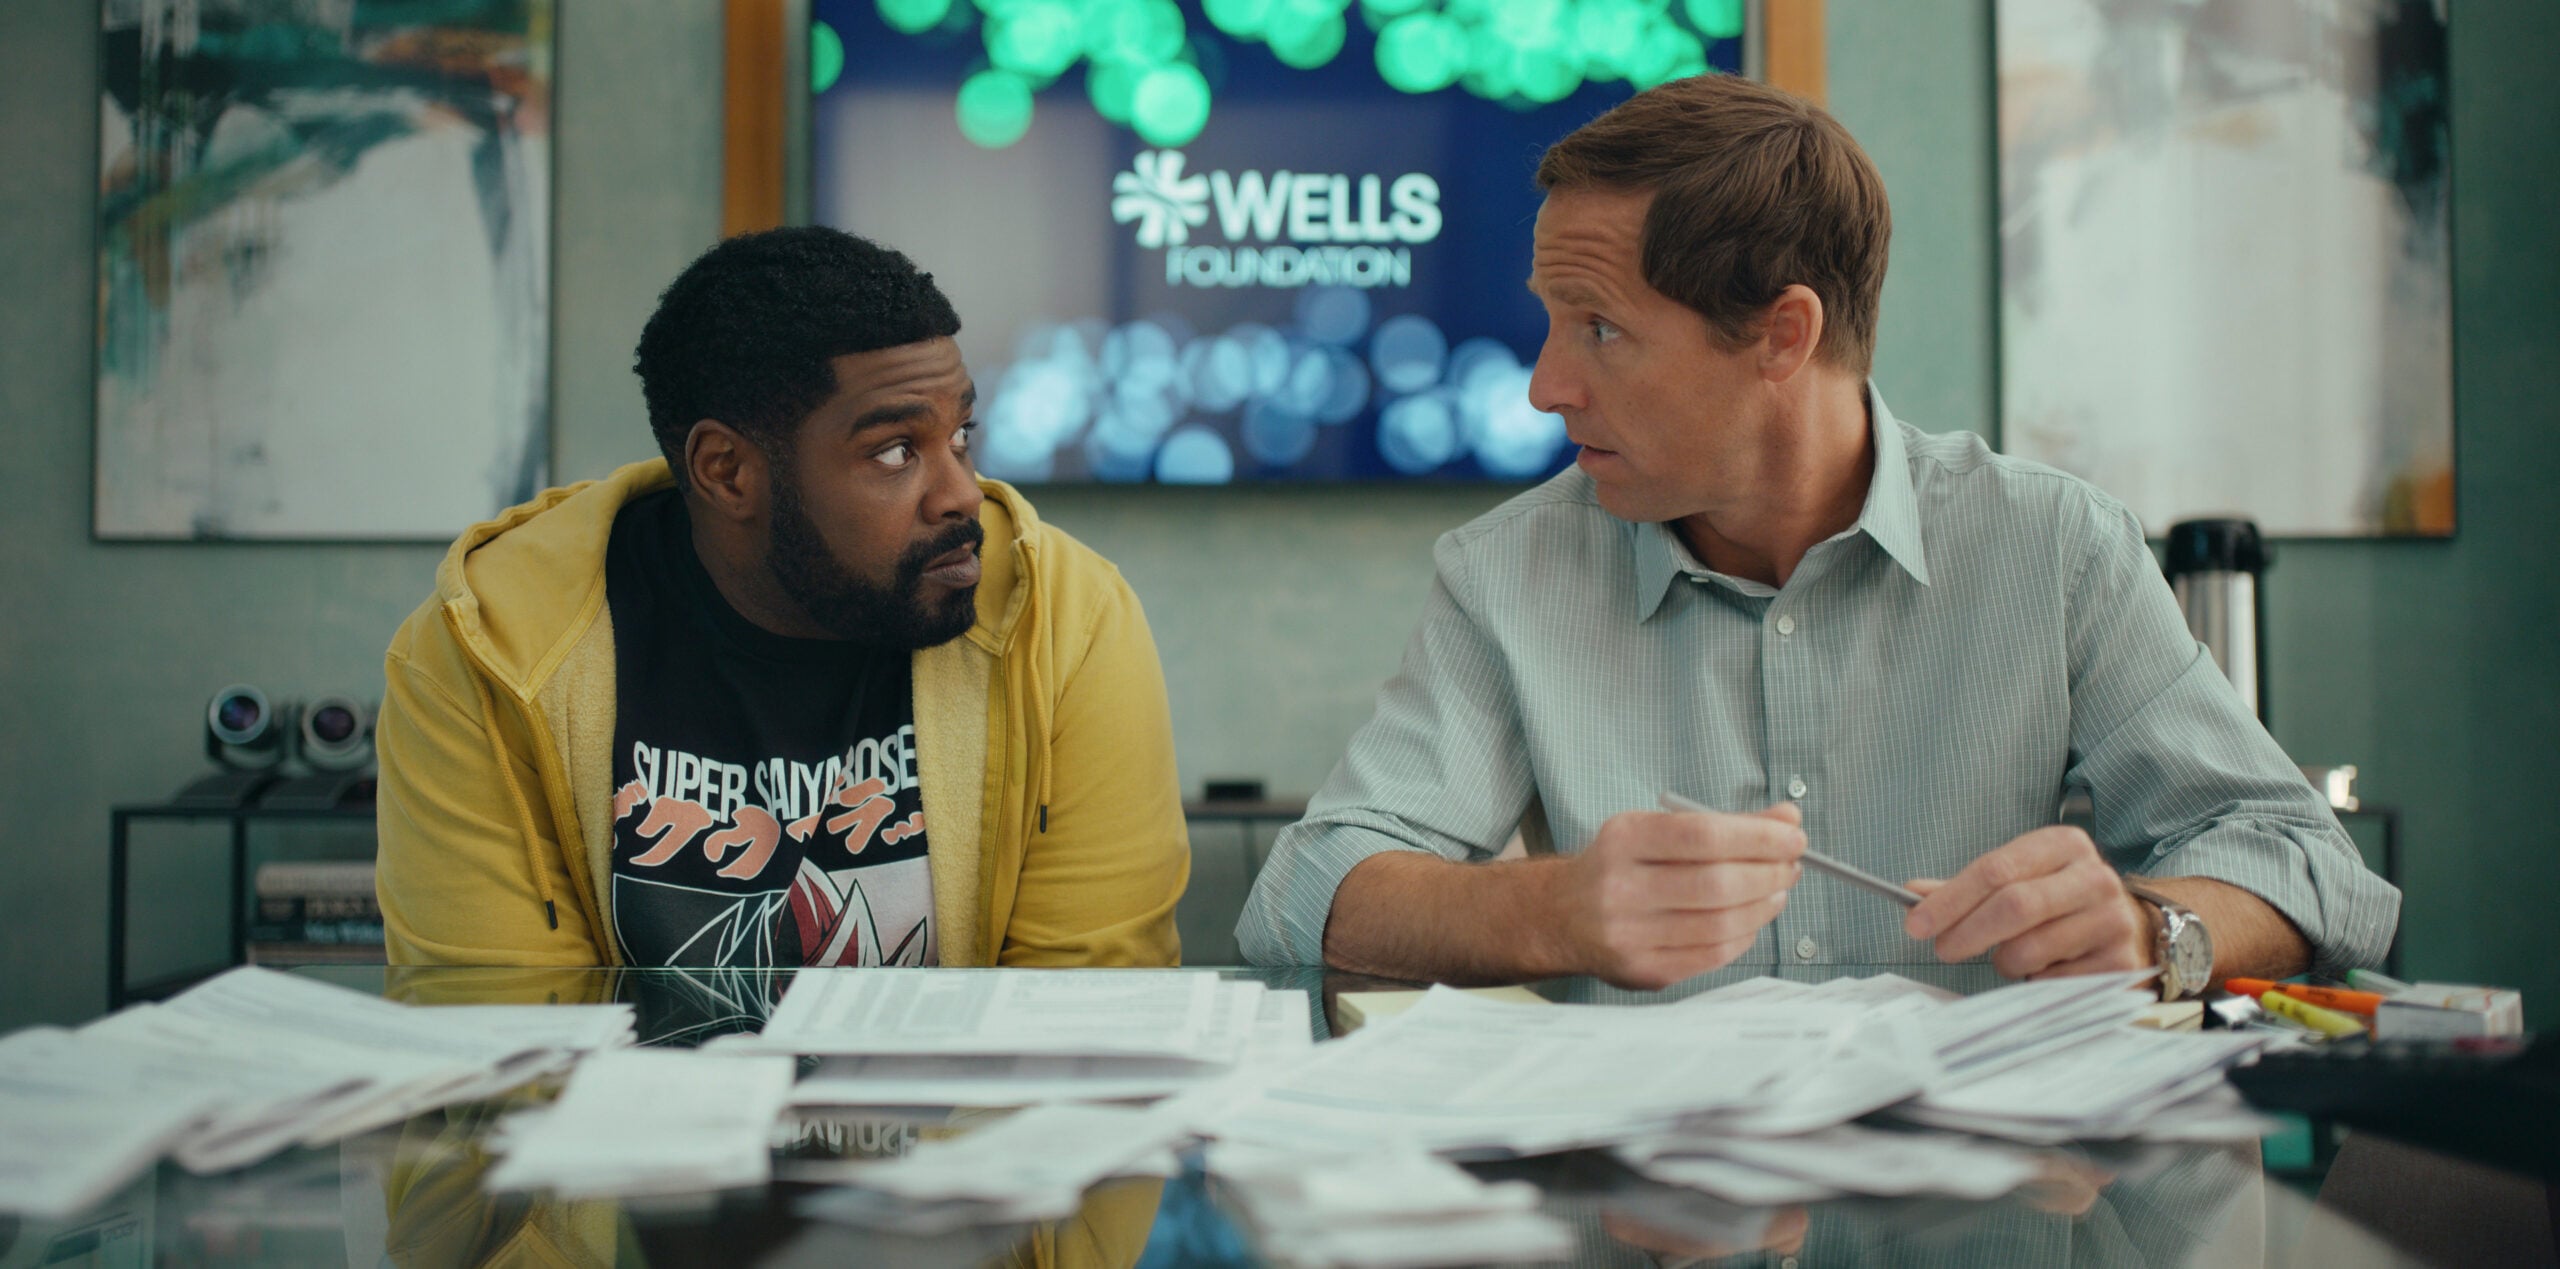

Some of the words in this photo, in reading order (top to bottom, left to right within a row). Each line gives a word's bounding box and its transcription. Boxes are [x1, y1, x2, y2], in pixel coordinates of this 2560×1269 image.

[1209, 169, 1443, 244] WELLS
[1165, 246, 1411, 288] FOUNDATION
[634, 741, 748, 824] SUPER
[755, 755, 842, 821] SAIYA
